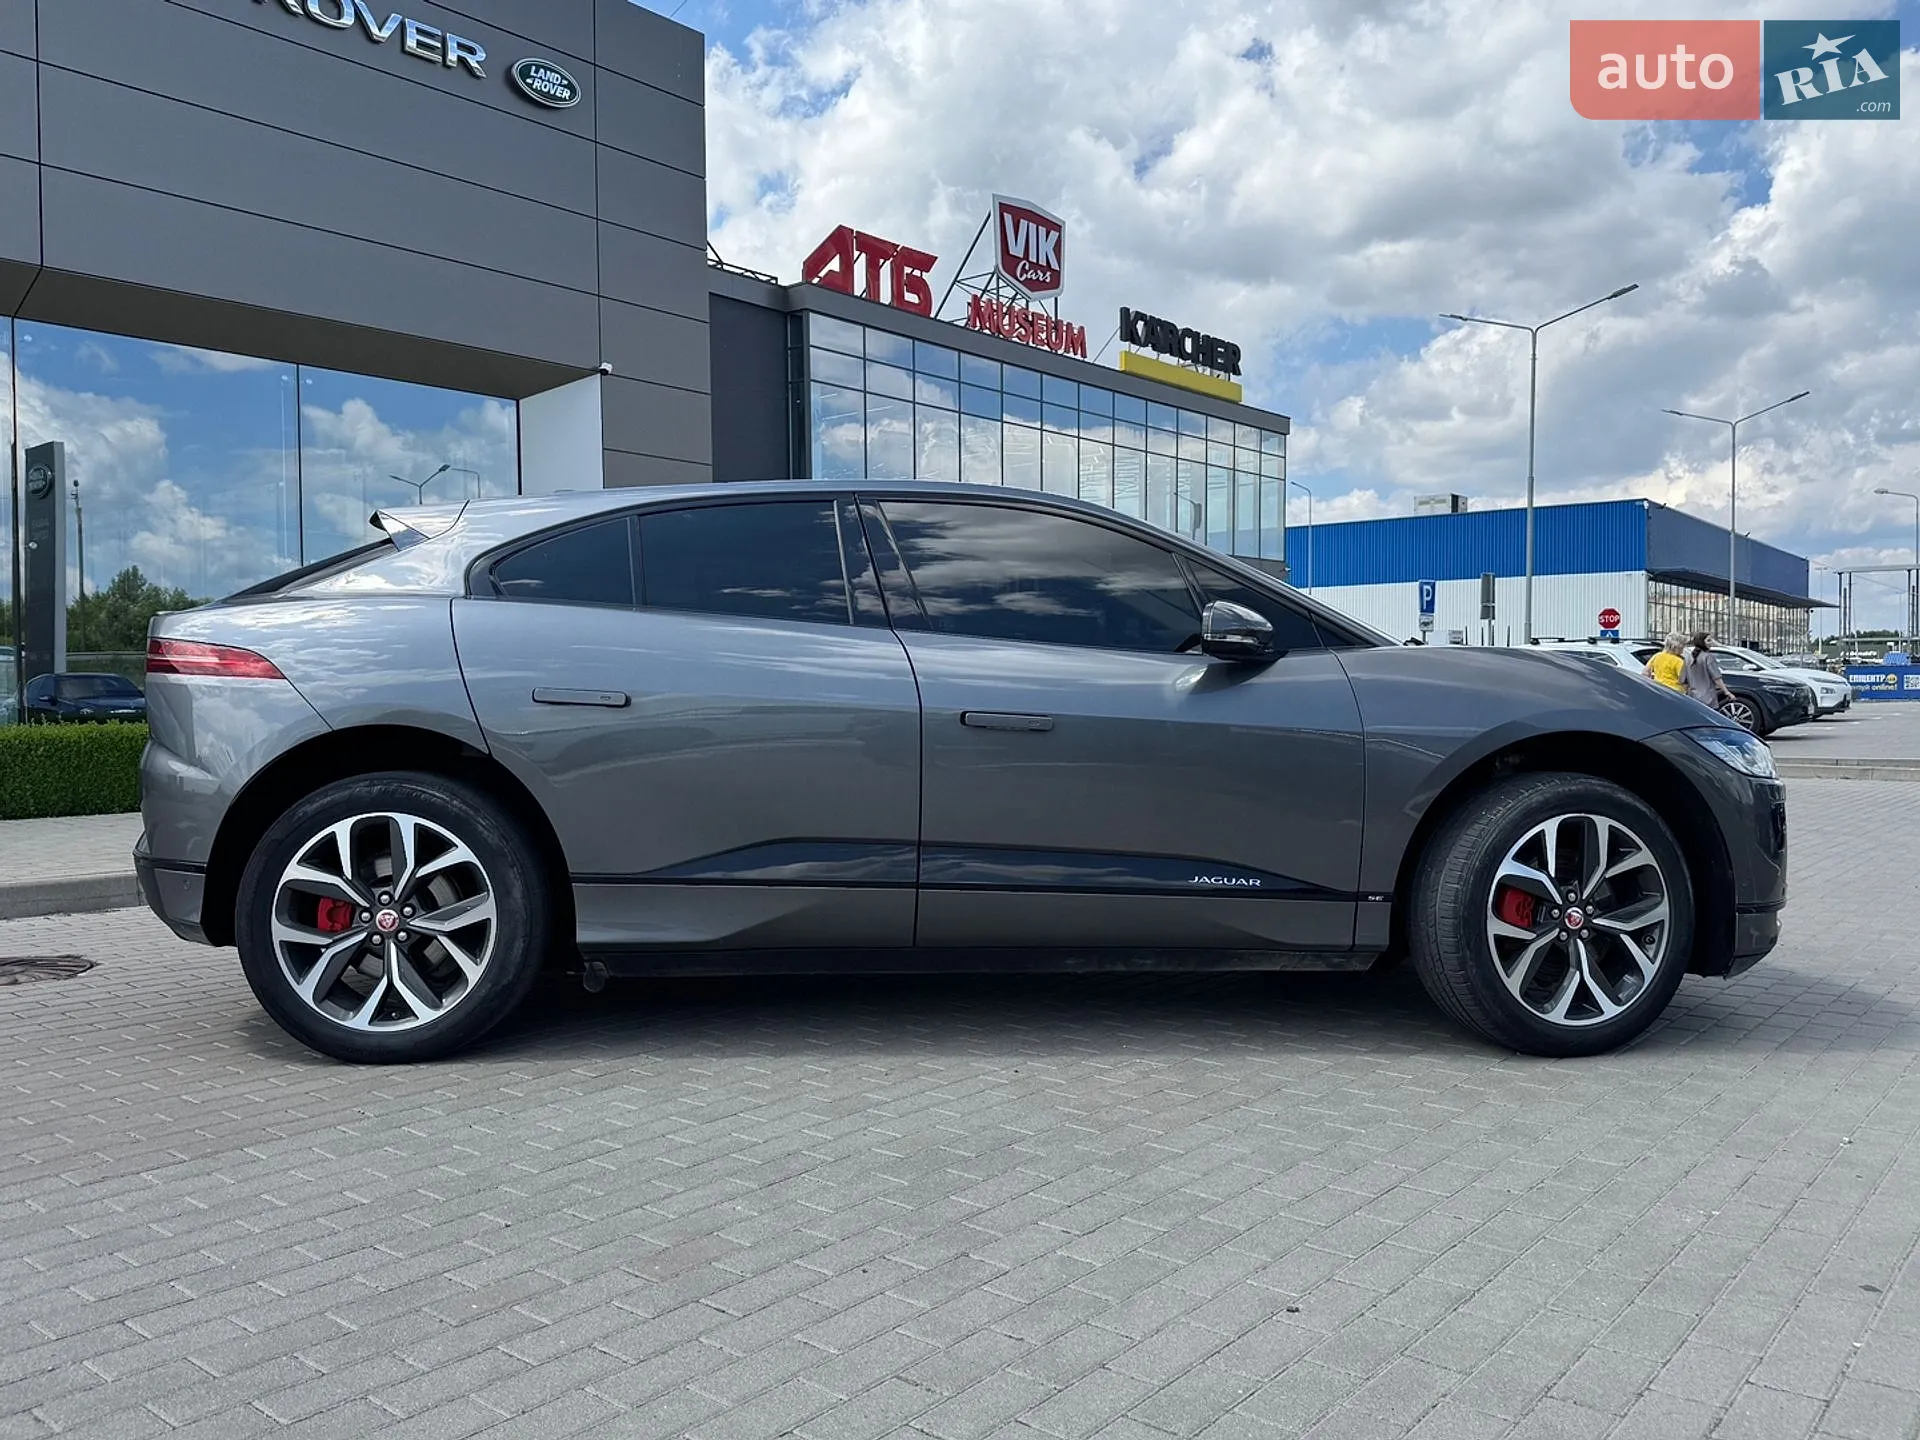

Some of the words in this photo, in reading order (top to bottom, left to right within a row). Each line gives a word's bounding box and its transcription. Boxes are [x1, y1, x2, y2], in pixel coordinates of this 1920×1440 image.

[251, 0, 487, 79] OVER
[529, 65, 561, 85] LAND
[532, 77, 572, 100] ROVER
[1003, 212, 1060, 271] VIK
[802, 224, 939, 318] АТБ
[1016, 260, 1051, 282] Cars
[969, 294, 1088, 359] MUSEUM
[1422, 584, 1432, 609] P
[1599, 614, 1621, 623] STOP
[1188, 875, 1261, 887] JAGUAR
